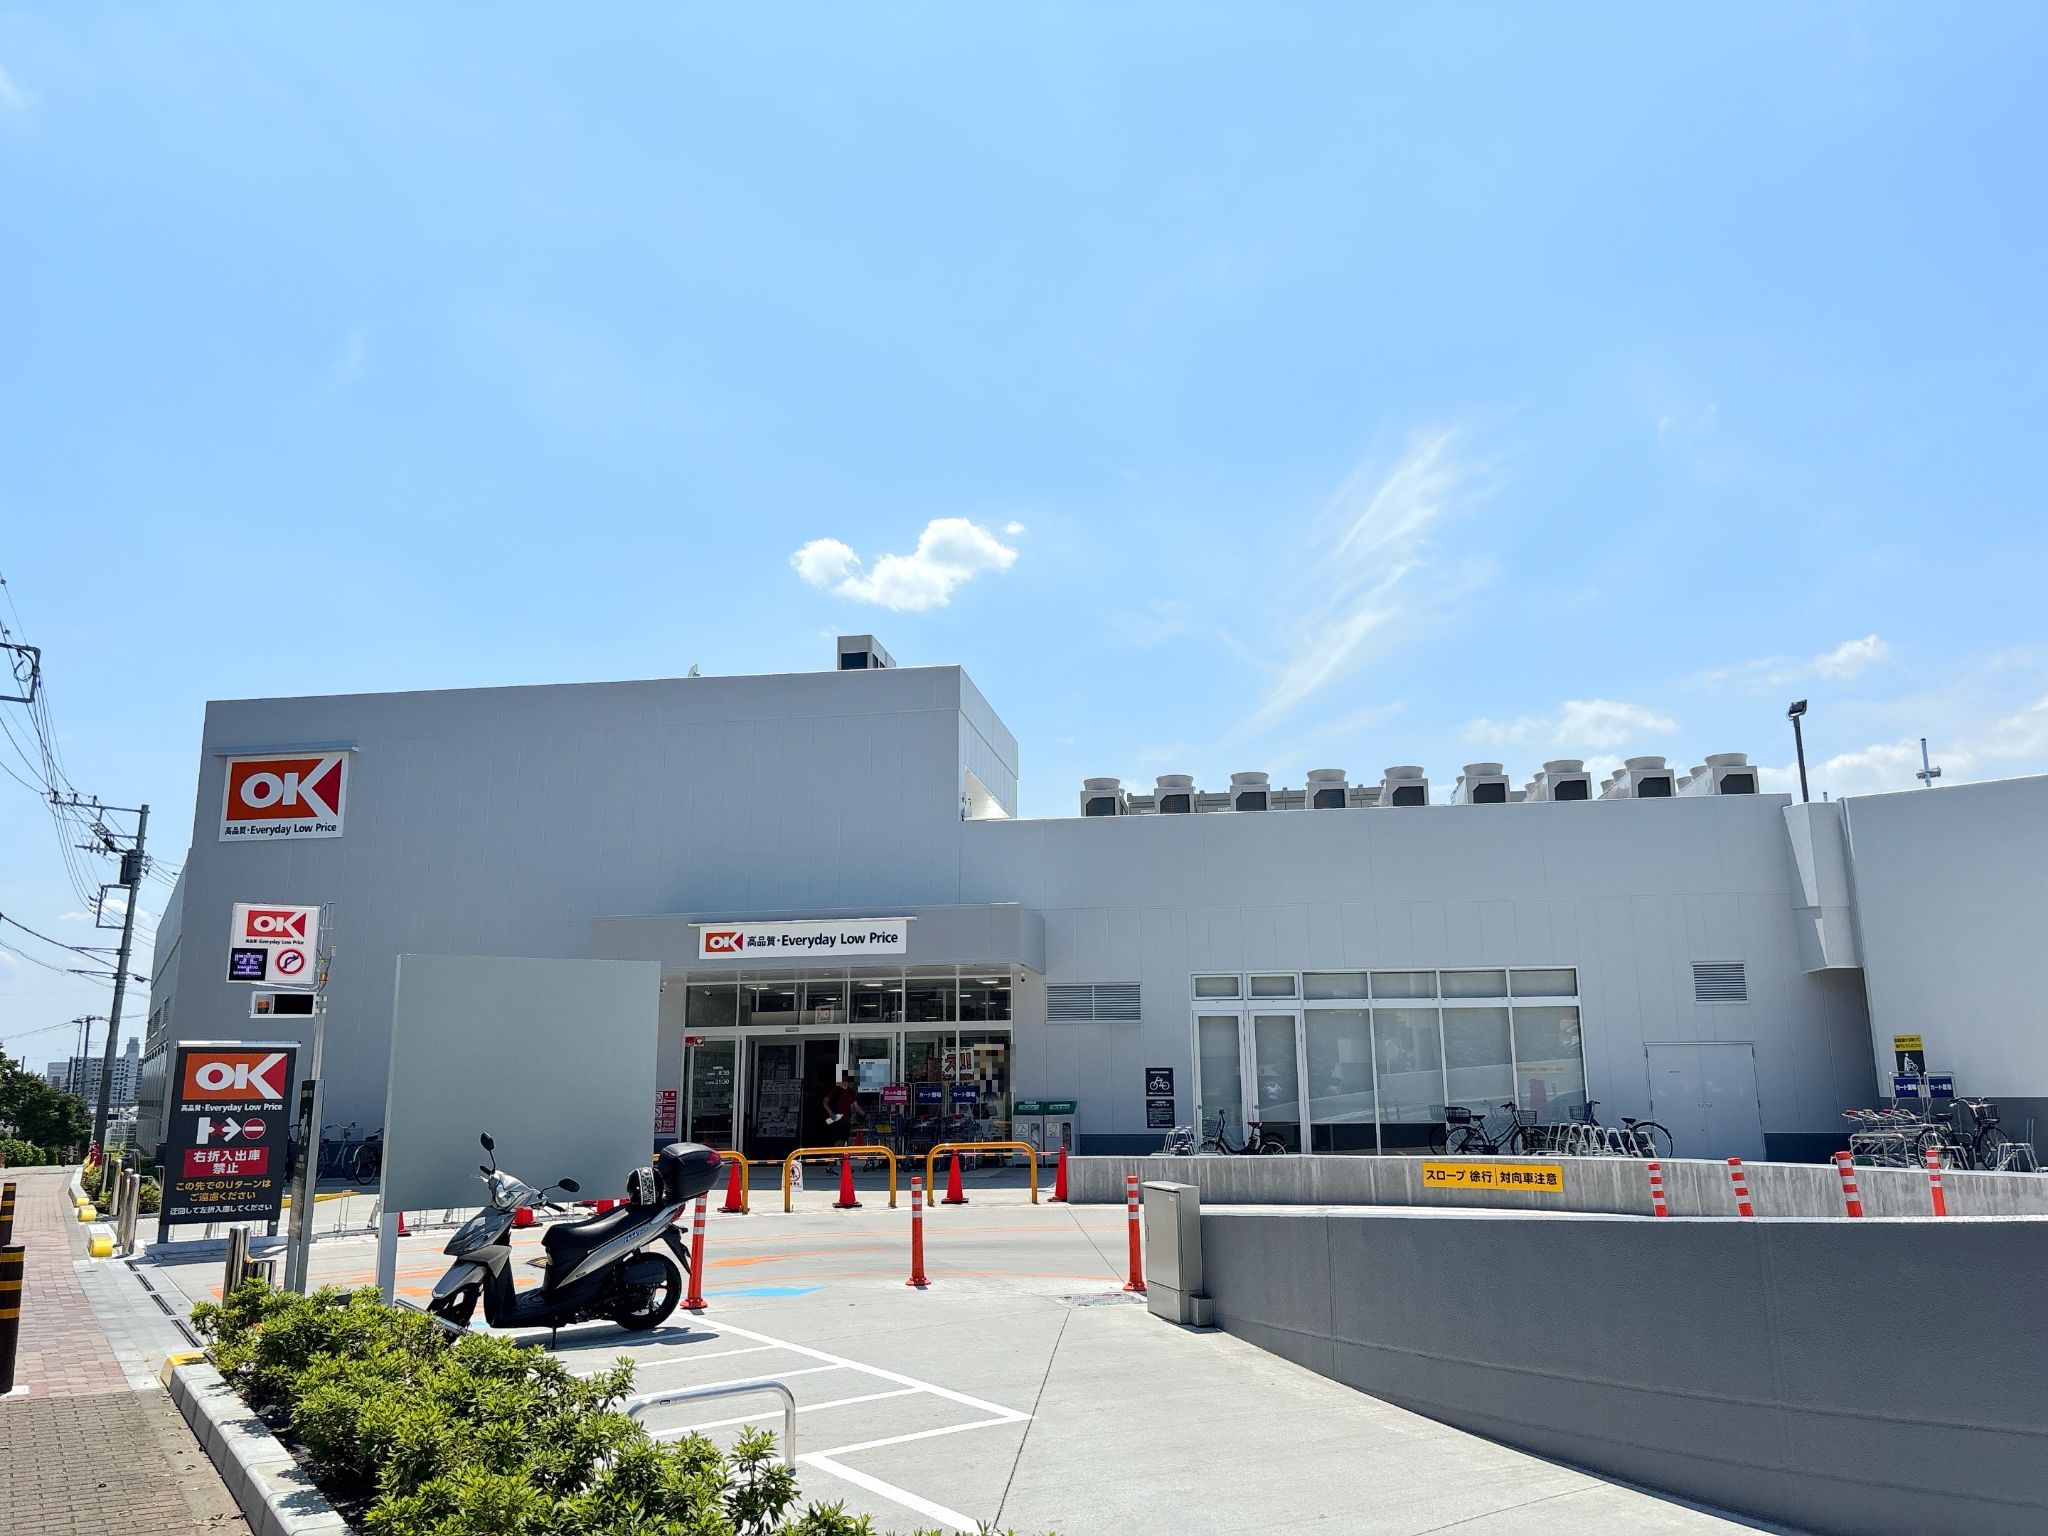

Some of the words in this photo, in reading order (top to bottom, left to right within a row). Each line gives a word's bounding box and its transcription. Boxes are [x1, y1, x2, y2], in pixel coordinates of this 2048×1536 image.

[240, 757, 342, 817] OK
[294, 823, 313, 833] Low
[315, 822, 337, 833] Price
[253, 912, 306, 939] OK
[709, 932, 743, 951] OK
[840, 933, 866, 945] Low
[870, 931, 898, 944] Price
[196, 1053, 288, 1099] OK
[244, 1103, 262, 1111] Low
[264, 1103, 283, 1111] Price
[193, 1149, 261, 1163] 右折入出庫
[212, 1163, 239, 1174] 禁止
[1426, 1169, 1466, 1181] スロープ
[1469, 1170, 1492, 1183] 徐行
[1500, 1171, 1557, 1186] 対向車注意
[189, 1191, 256, 1202] ご遠慮ください
